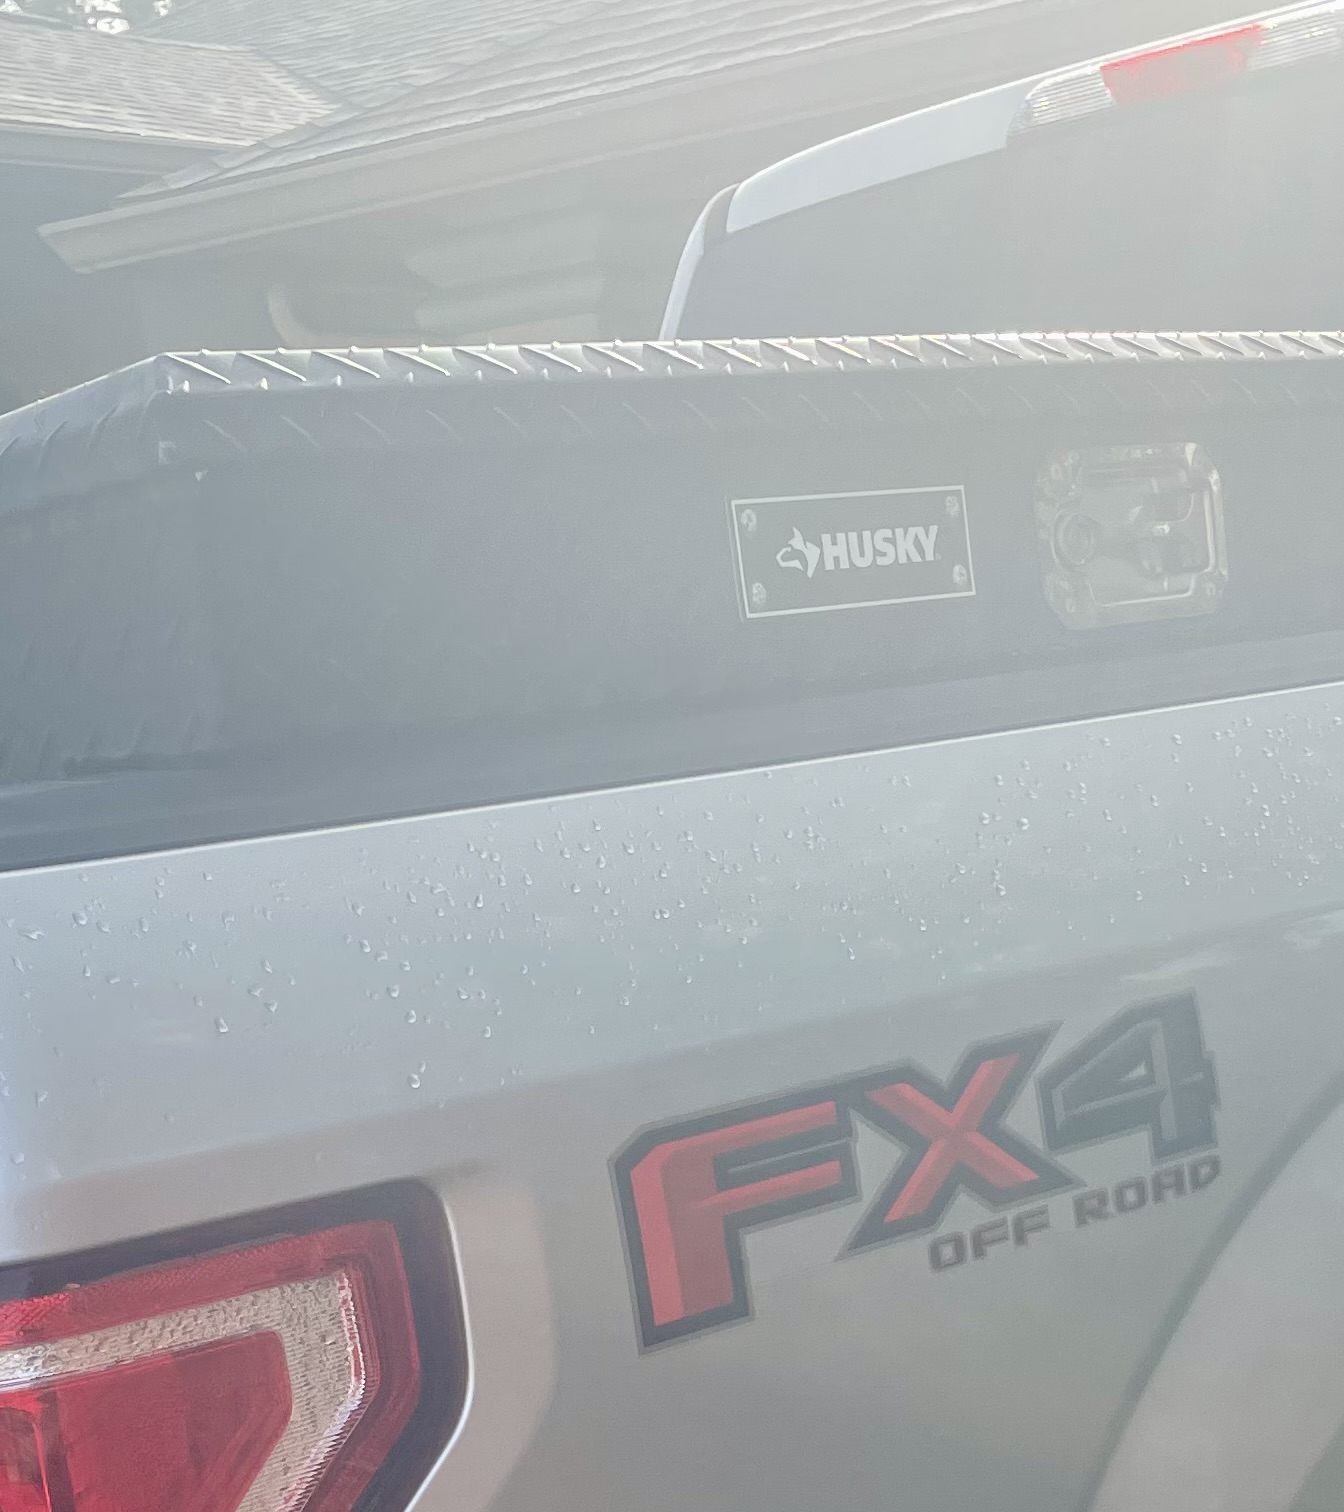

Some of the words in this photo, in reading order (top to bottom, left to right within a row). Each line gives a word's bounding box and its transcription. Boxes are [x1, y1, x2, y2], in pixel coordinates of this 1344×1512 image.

[820, 524, 939, 571] HUSKY
[607, 987, 1222, 1358] FX4
[928, 1203, 1052, 1273] OFF
[1072, 1154, 1223, 1229] ROAD
